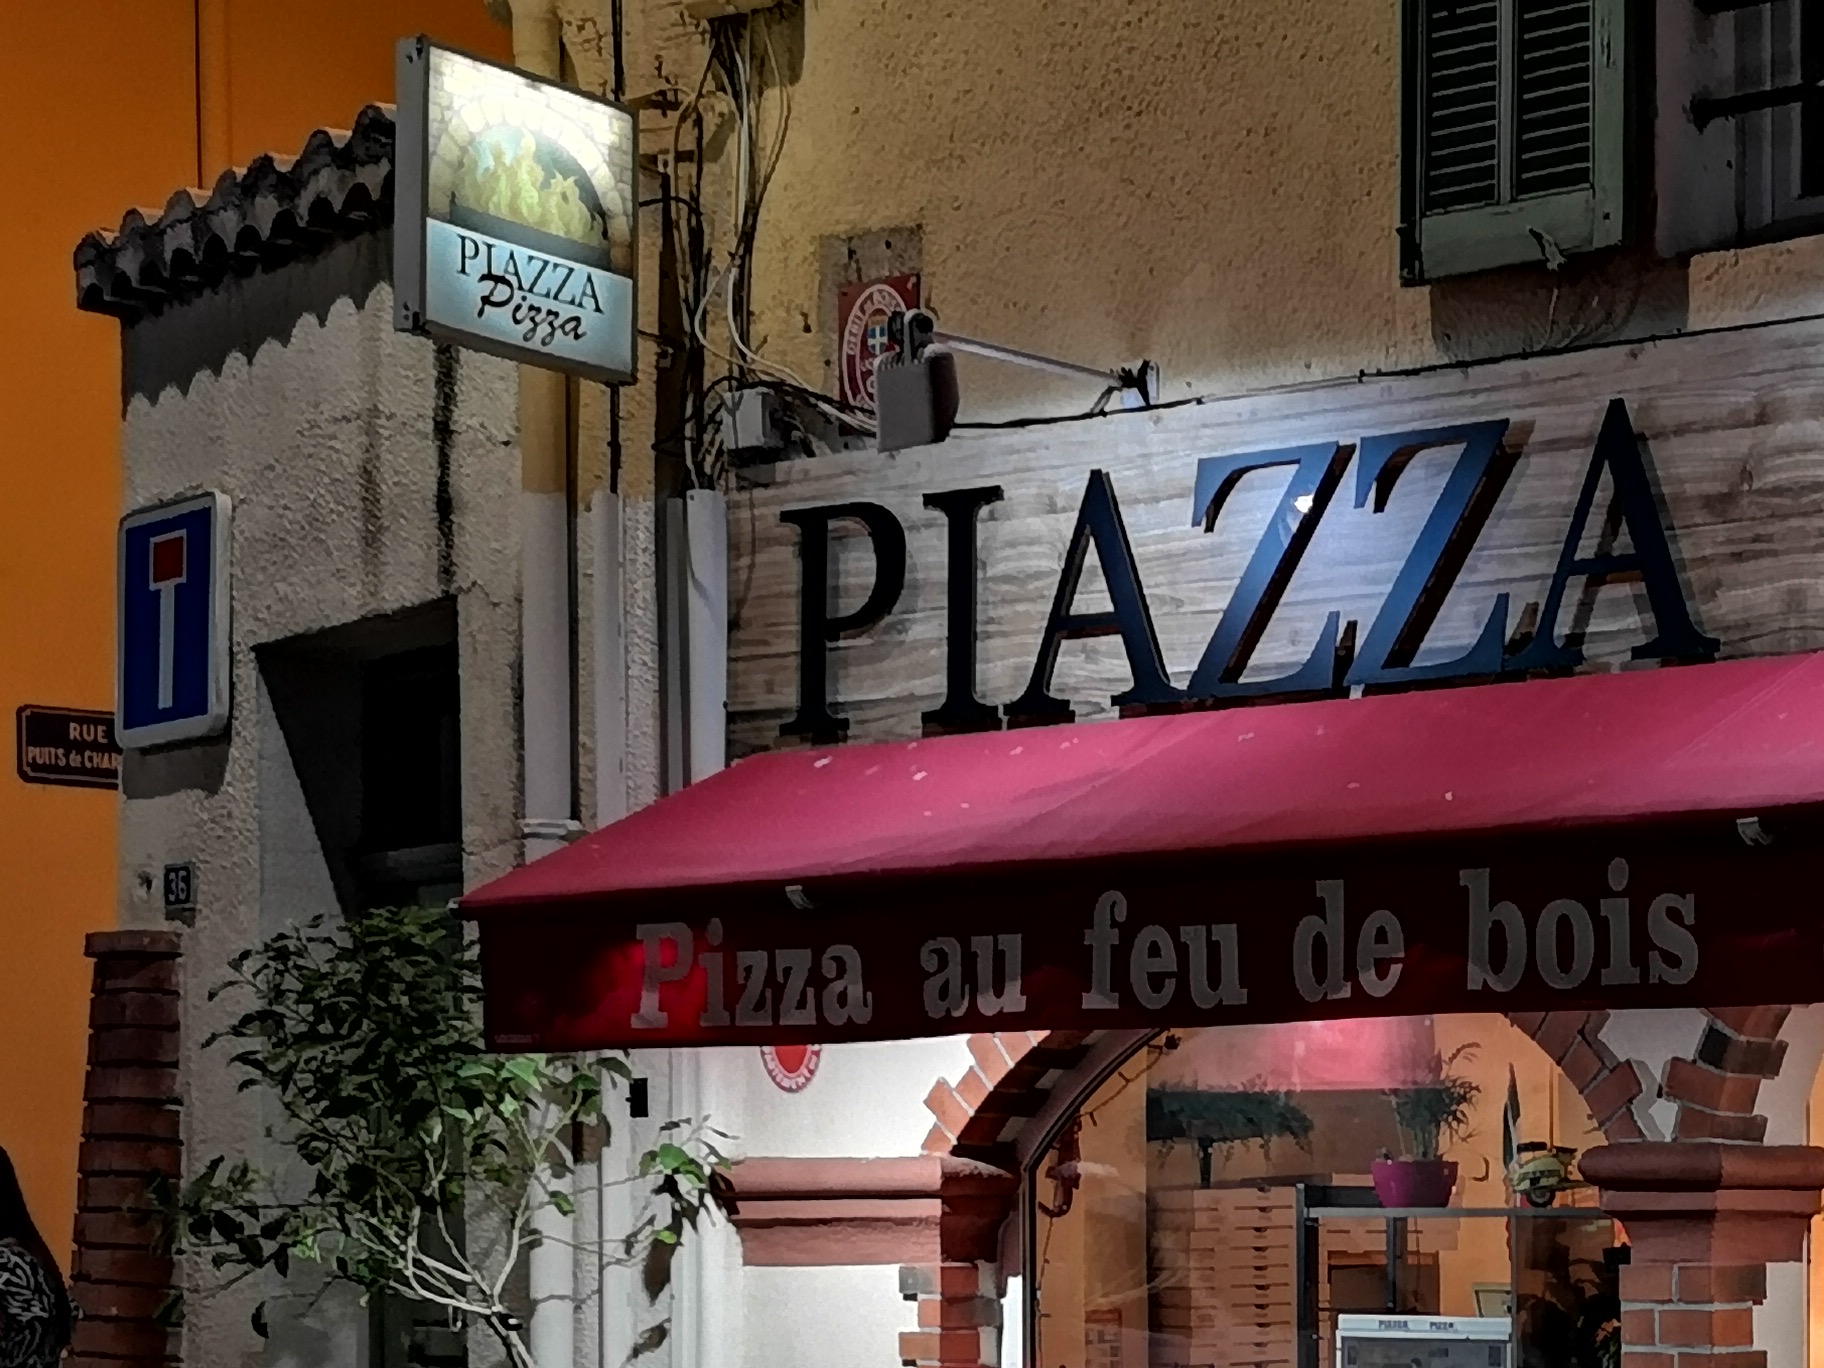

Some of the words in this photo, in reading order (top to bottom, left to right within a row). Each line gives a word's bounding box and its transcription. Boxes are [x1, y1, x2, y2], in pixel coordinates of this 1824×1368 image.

[456, 233, 605, 315] PIAZZA
[477, 273, 588, 347] Pizza
[779, 397, 1721, 739] PIAZZA
[27, 745, 67, 767] PUITS
[68, 721, 109, 744] RUE
[168, 870, 188, 902] 36
[630, 917, 873, 1030] Pizza
[920, 933, 1027, 1020] au
[1082, 889, 1248, 1010] feu
[1293, 878, 1406, 1003] de
[1459, 857, 1699, 993] bois
